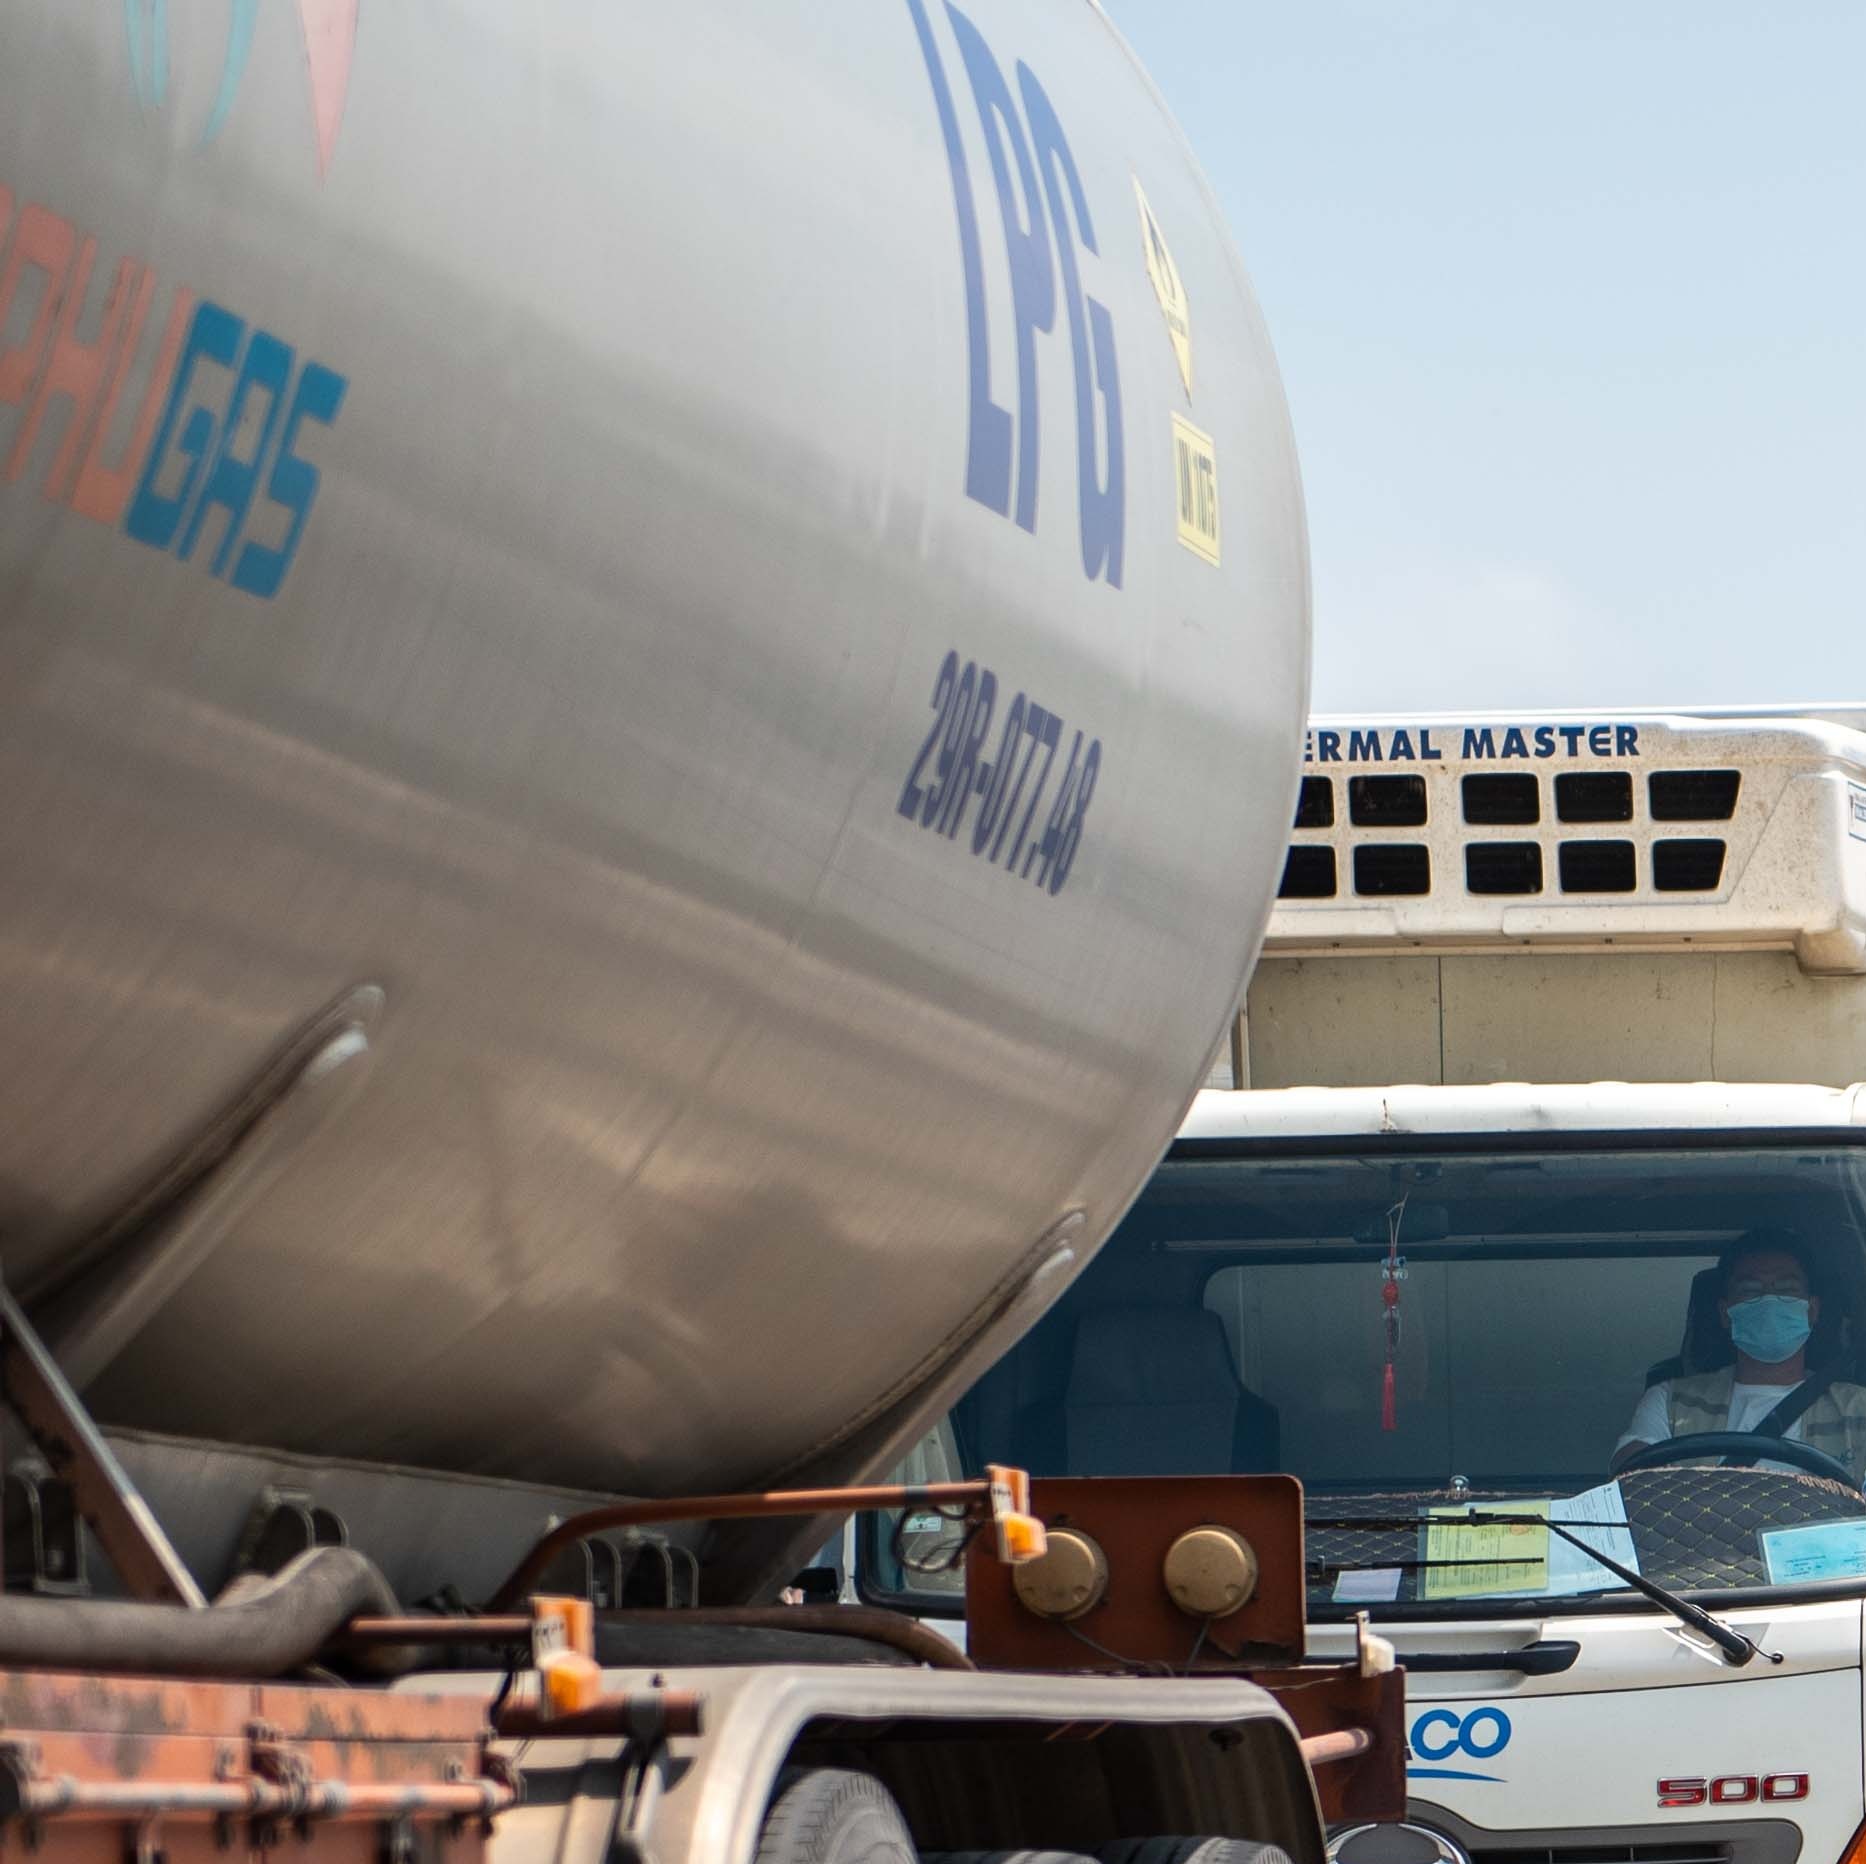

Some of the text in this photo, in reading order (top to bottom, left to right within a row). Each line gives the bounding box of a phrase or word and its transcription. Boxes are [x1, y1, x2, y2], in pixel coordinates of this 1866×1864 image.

[904, 0, 1126, 591] LPG
[0, 182, 348, 600] PHUGAS
[1304, 725, 1640, 762] RMAL MASTER
[1404, 1706, 1511, 1761] CO
[1656, 1771, 1810, 1809] 500
